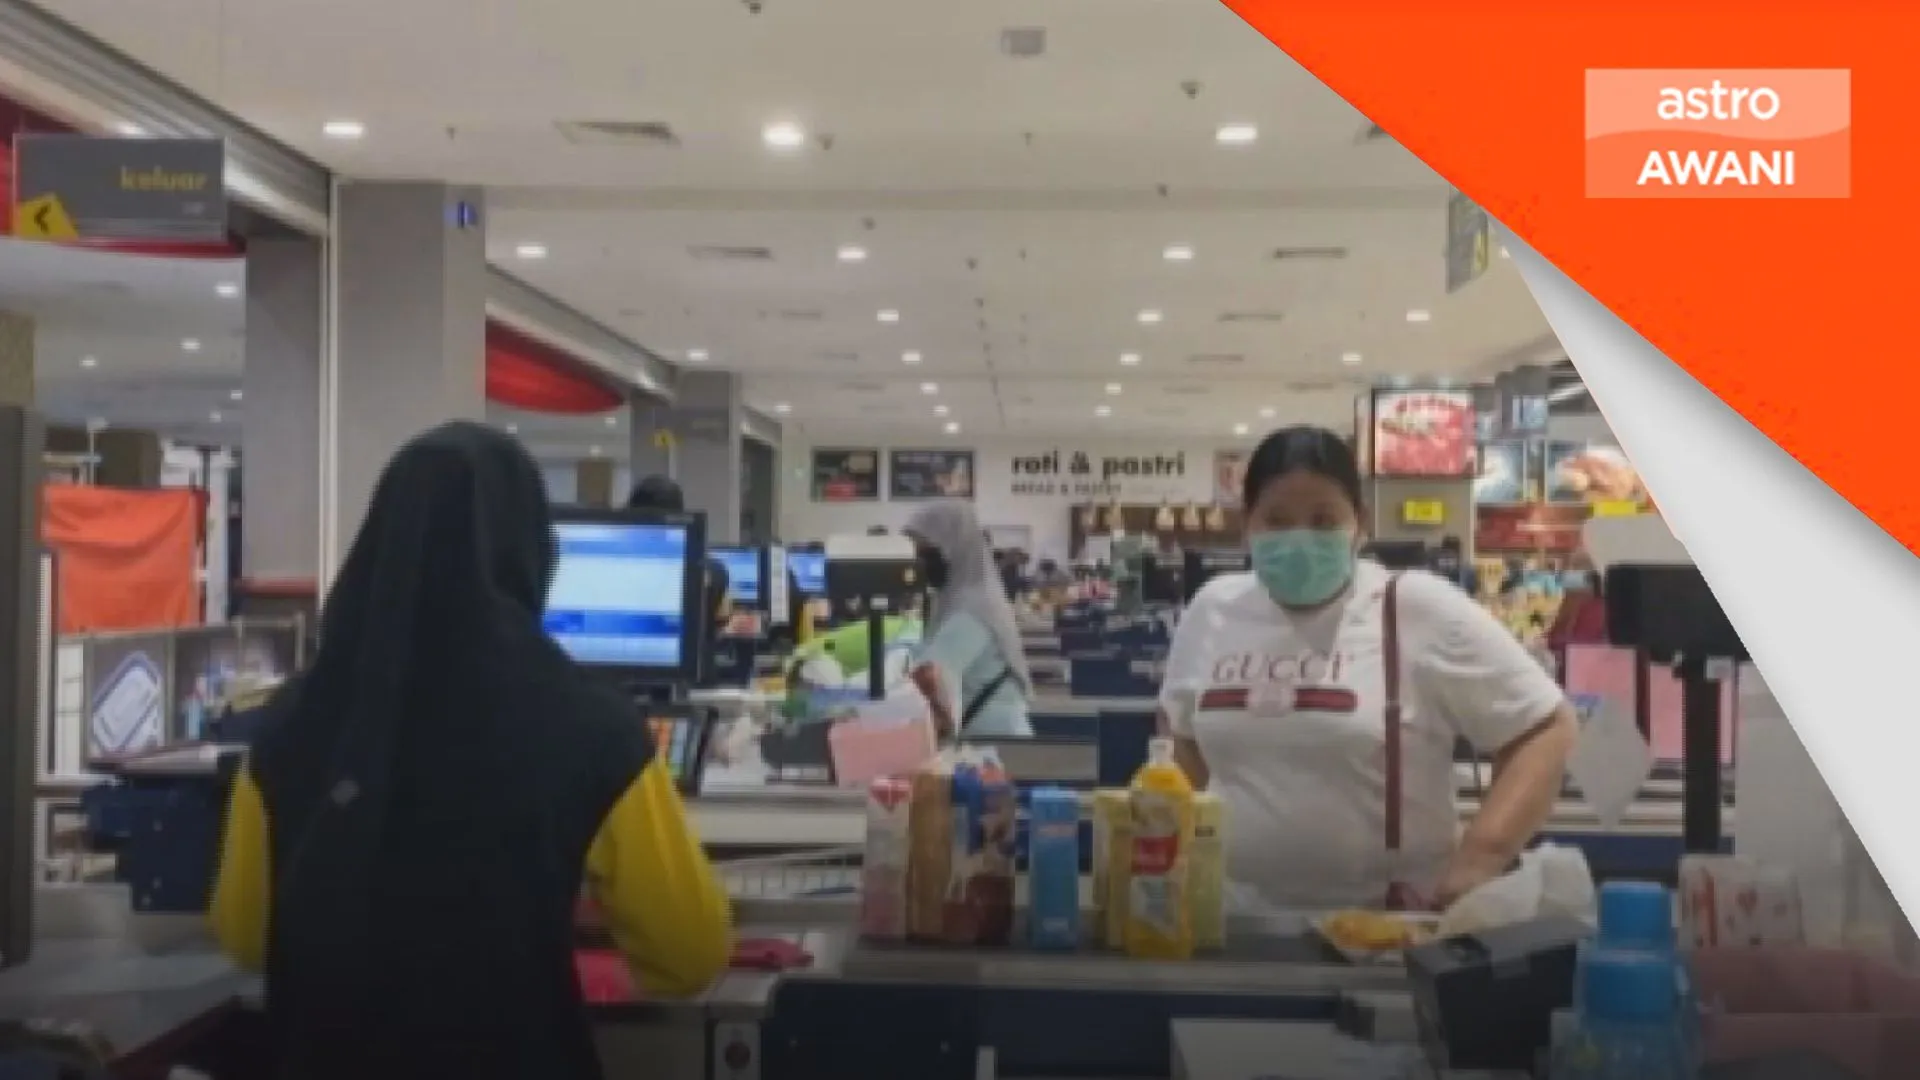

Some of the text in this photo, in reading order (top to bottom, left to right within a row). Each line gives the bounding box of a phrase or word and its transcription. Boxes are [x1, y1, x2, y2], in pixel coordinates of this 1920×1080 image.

[119, 165, 208, 191] keluar
[1012, 447, 1058, 475] roti
[1102, 451, 1186, 481] pastri
[1212, 652, 1346, 685] GUCCI
